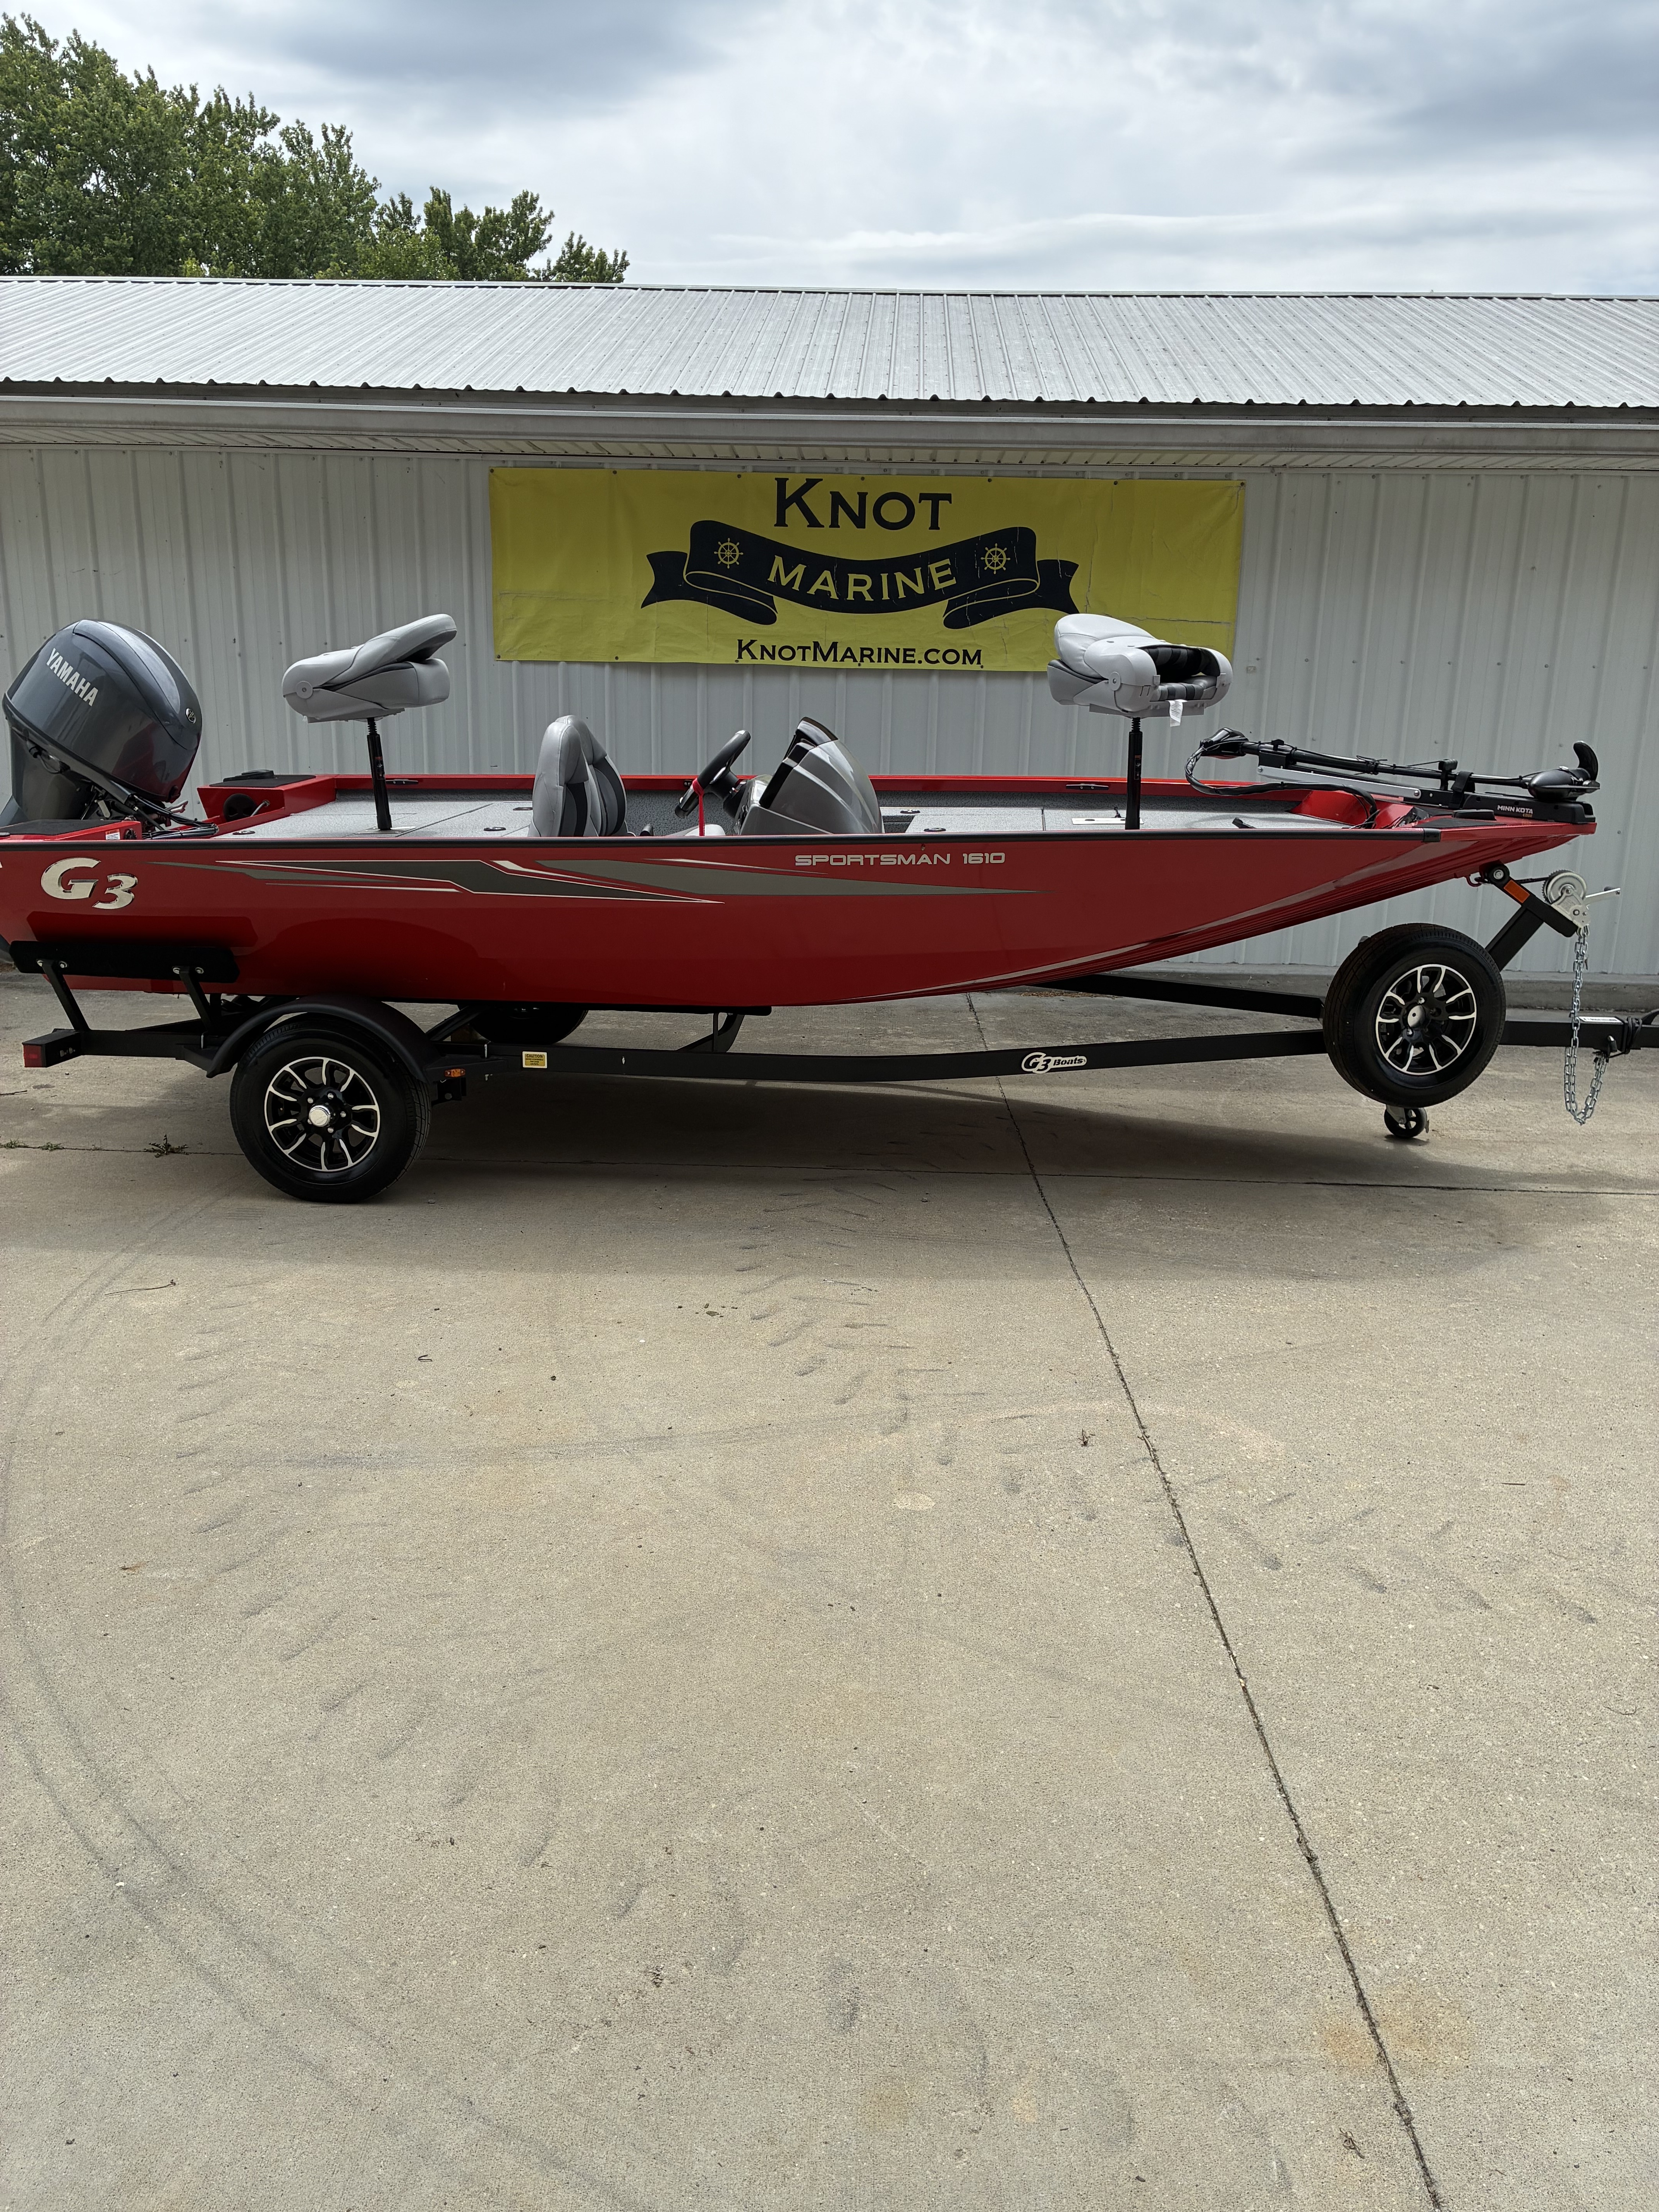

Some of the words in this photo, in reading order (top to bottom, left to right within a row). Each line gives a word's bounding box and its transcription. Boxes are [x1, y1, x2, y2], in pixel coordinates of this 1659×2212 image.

[768, 555, 957, 601] MARINE
[46, 647, 98, 706] YAMAHA
[795, 853, 951, 866] SPORTSMAN
[962, 853, 1005, 864] 1610
[41, 857, 138, 909] G3
[1024, 1054, 1051, 1071] G3
[1053, 1058, 1083, 1066] Boats
